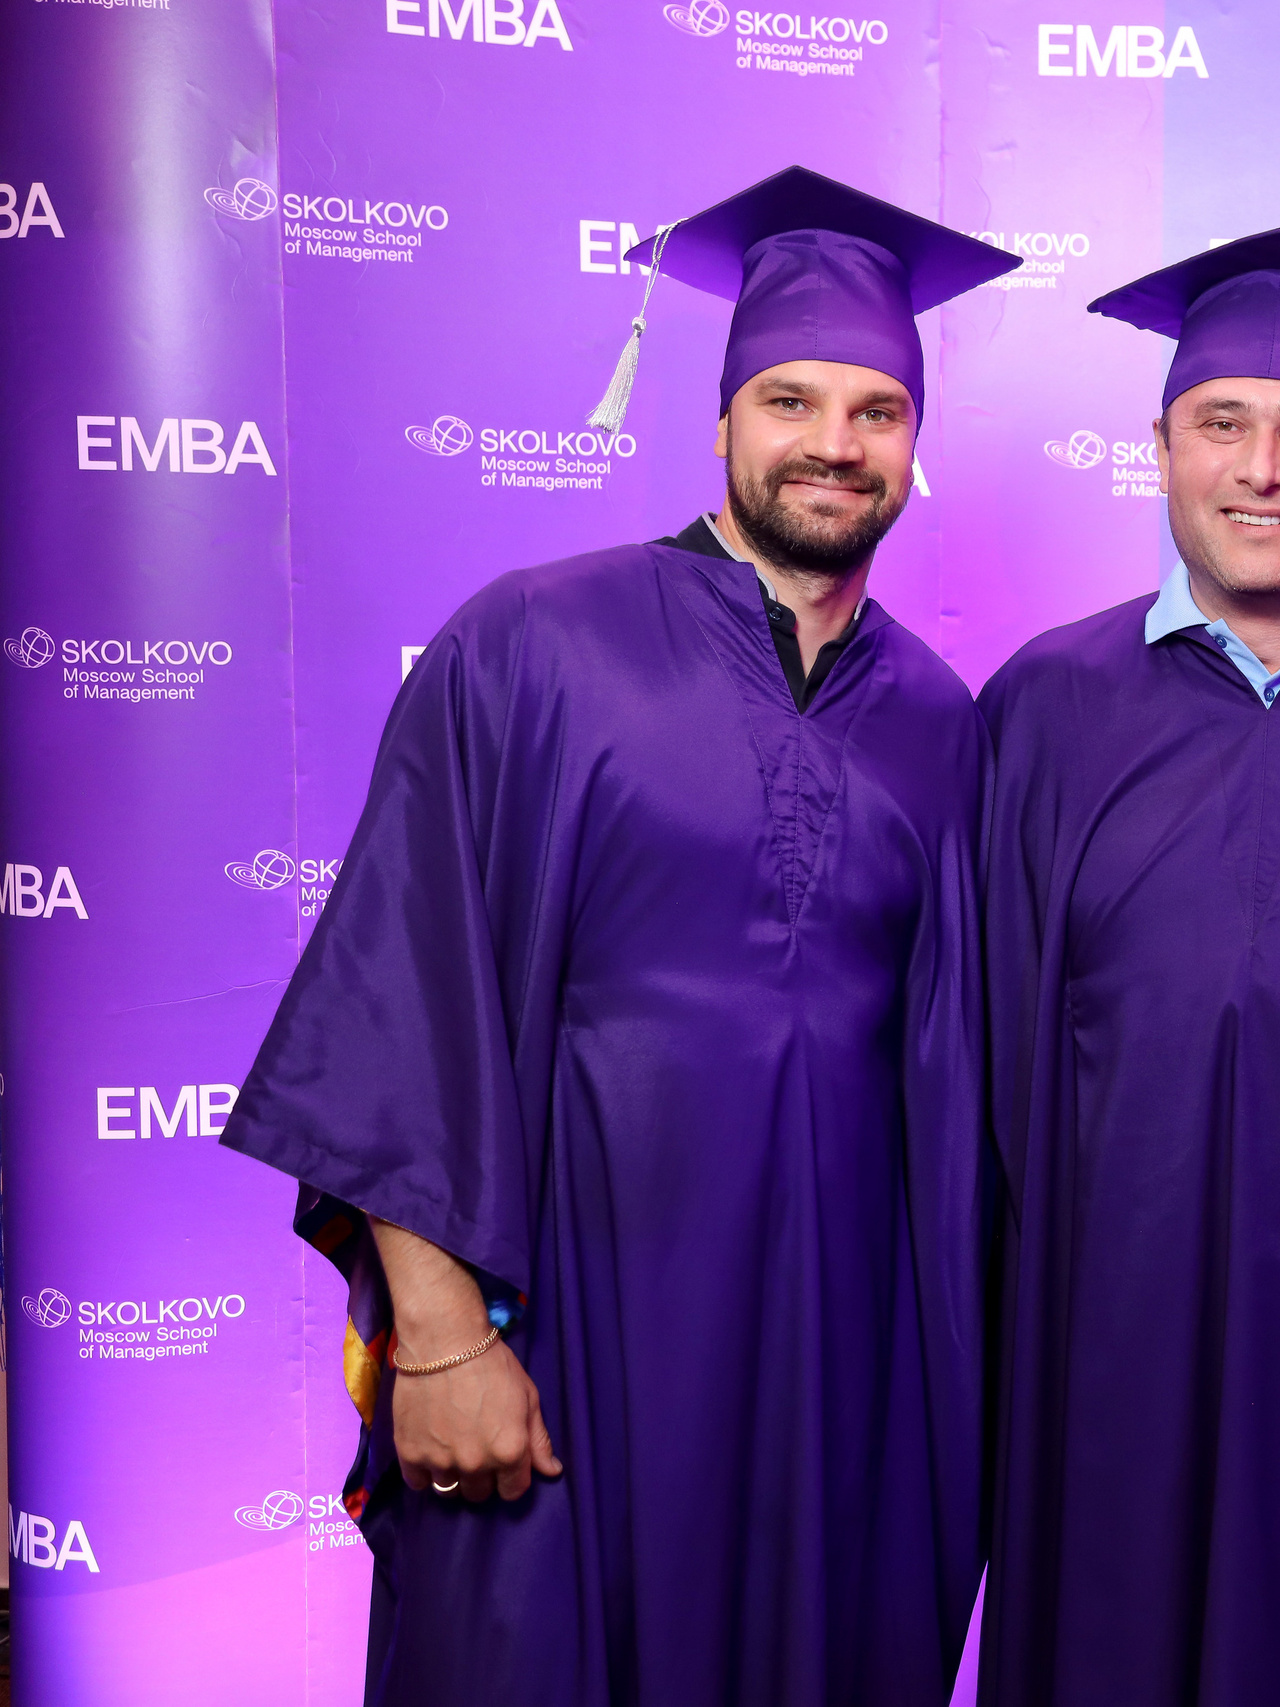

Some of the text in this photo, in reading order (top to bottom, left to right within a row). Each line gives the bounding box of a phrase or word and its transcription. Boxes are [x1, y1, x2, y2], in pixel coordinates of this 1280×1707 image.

[55, 0, 170, 10] gement
[386, 0, 573, 51] EMBA
[736, 10, 888, 44] SKOLKOVO
[737, 37, 862, 60] Moscow School
[1038, 24, 1209, 78] EMBA
[736, 55, 854, 76] of Management
[0, 182, 66, 239] BA
[283, 194, 448, 230] SKOLKOVO
[285, 222, 421, 246] Moscow School
[962, 231, 1090, 257] OLKOVO
[285, 240, 413, 262] of Management
[77, 416, 277, 476] EMBA
[480, 428, 637, 458] SKOLKOVO
[482, 456, 610, 474] Moscow School
[481, 472, 602, 491] of Management
[1112, 482, 1168, 497] of Man
[62, 640, 232, 665] SKOLKOVO
[64, 668, 203, 683] Moscow School
[64, 685, 194, 702] of Management
[300, 859, 344, 883] SK
[0, 863, 89, 920] MBA
[301, 902, 317, 917] of
[78, 1295, 245, 1325] SKOLKOVO
[80, 1323, 216, 1342] Moscow School
[79, 1341, 208, 1361] of Management
[9, 1502, 100, 1573] MBA
[310, 1520, 359, 1536] Mosc
[309, 1533, 366, 1551] of Man
